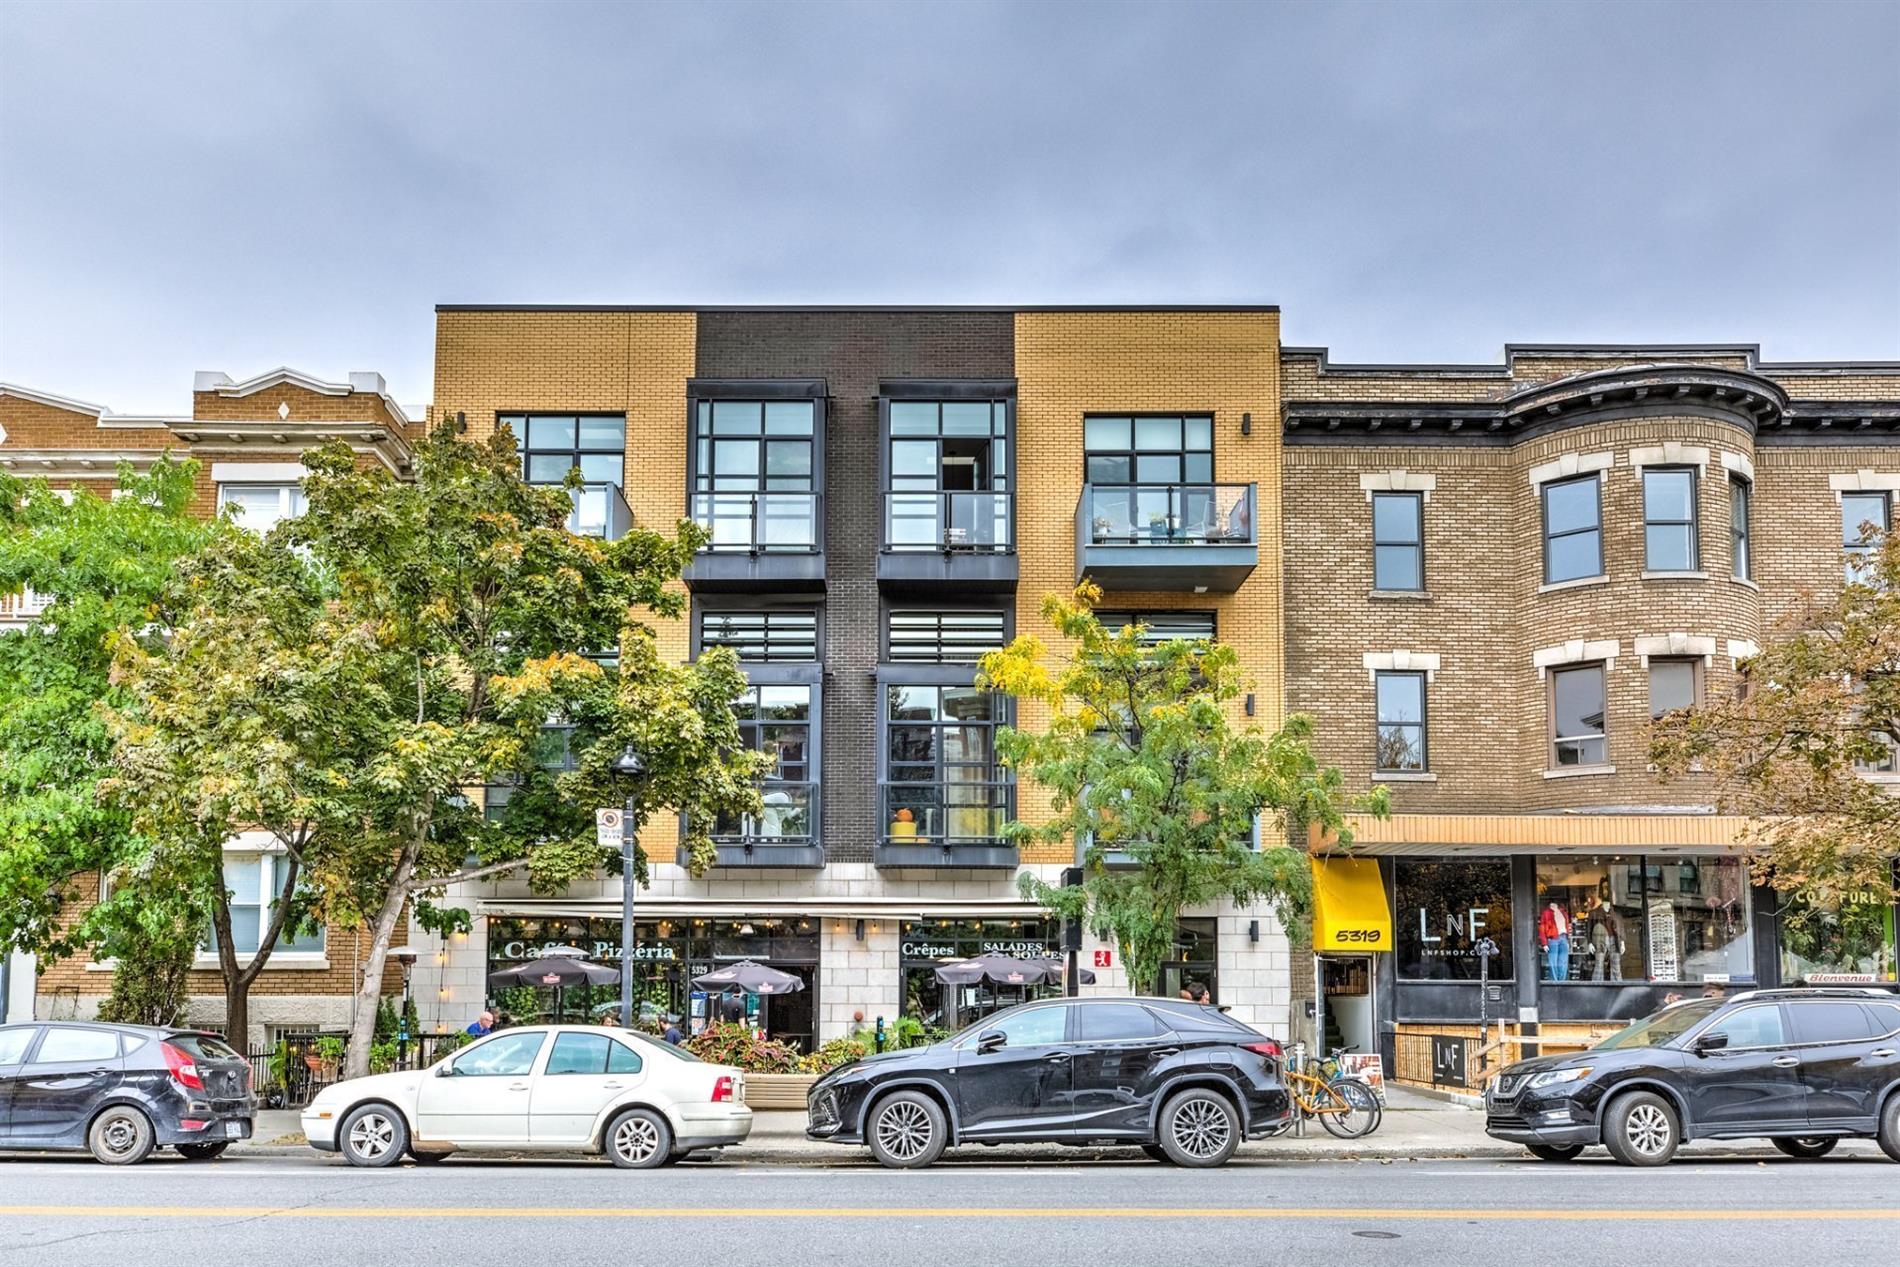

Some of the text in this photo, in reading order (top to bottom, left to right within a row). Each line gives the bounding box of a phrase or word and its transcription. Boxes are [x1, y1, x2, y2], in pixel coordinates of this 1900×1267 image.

[1796, 890, 1878, 904] COFURE
[1336, 930, 1381, 942] 5319
[594, 941, 674, 958] Pizéria
[902, 943, 954, 958] Crêpes
[984, 942, 1043, 951] SALADES
[691, 966, 707, 974] 5329
